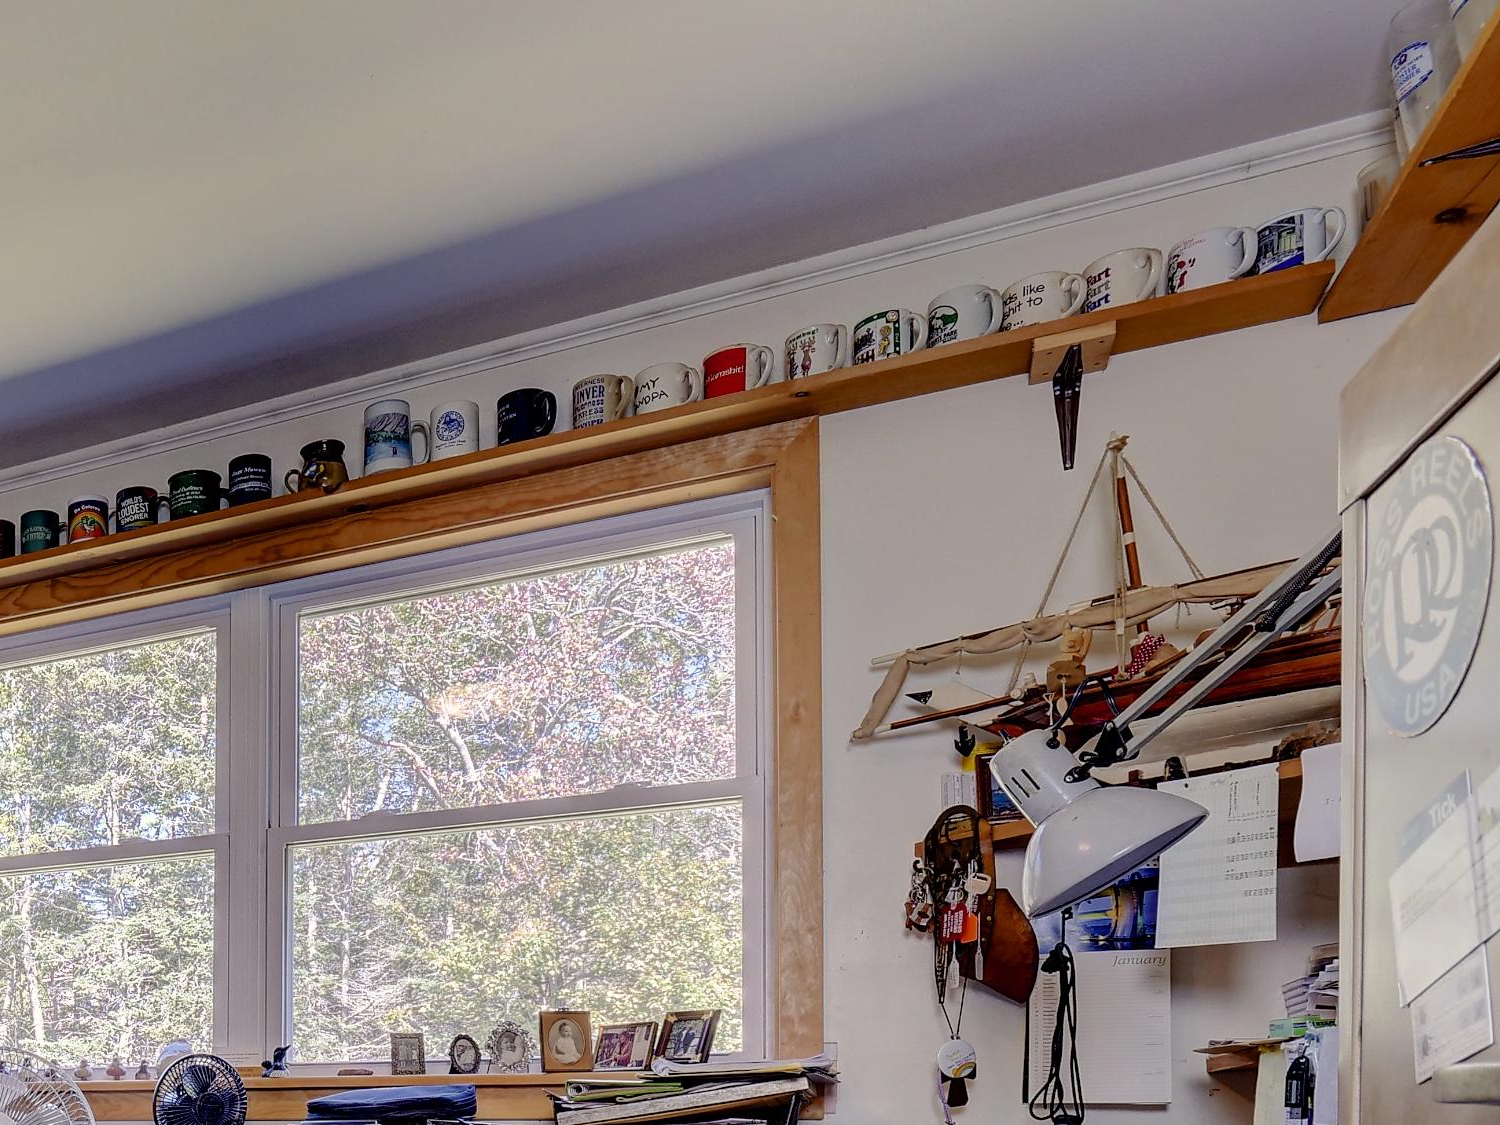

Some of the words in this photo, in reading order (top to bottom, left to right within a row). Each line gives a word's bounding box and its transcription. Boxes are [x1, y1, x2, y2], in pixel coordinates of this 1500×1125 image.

[1086, 266, 1111, 289] Fart
[1022, 283, 1045, 297] like
[1086, 279, 1111, 301] Fart
[1003, 301, 1022, 321] shit
[1027, 296, 1043, 308] to
[1085, 292, 1111, 313] Fart
[638, 376, 661, 396] MY
[120, 495, 143, 507] WORLD'S
[1411, 449, 1484, 549] REELS
[118, 502, 150, 520] LOUDEST
[120, 512, 149, 526] SNORER
[1404, 662, 1457, 725] USA
[1112, 955, 1167, 968] January
